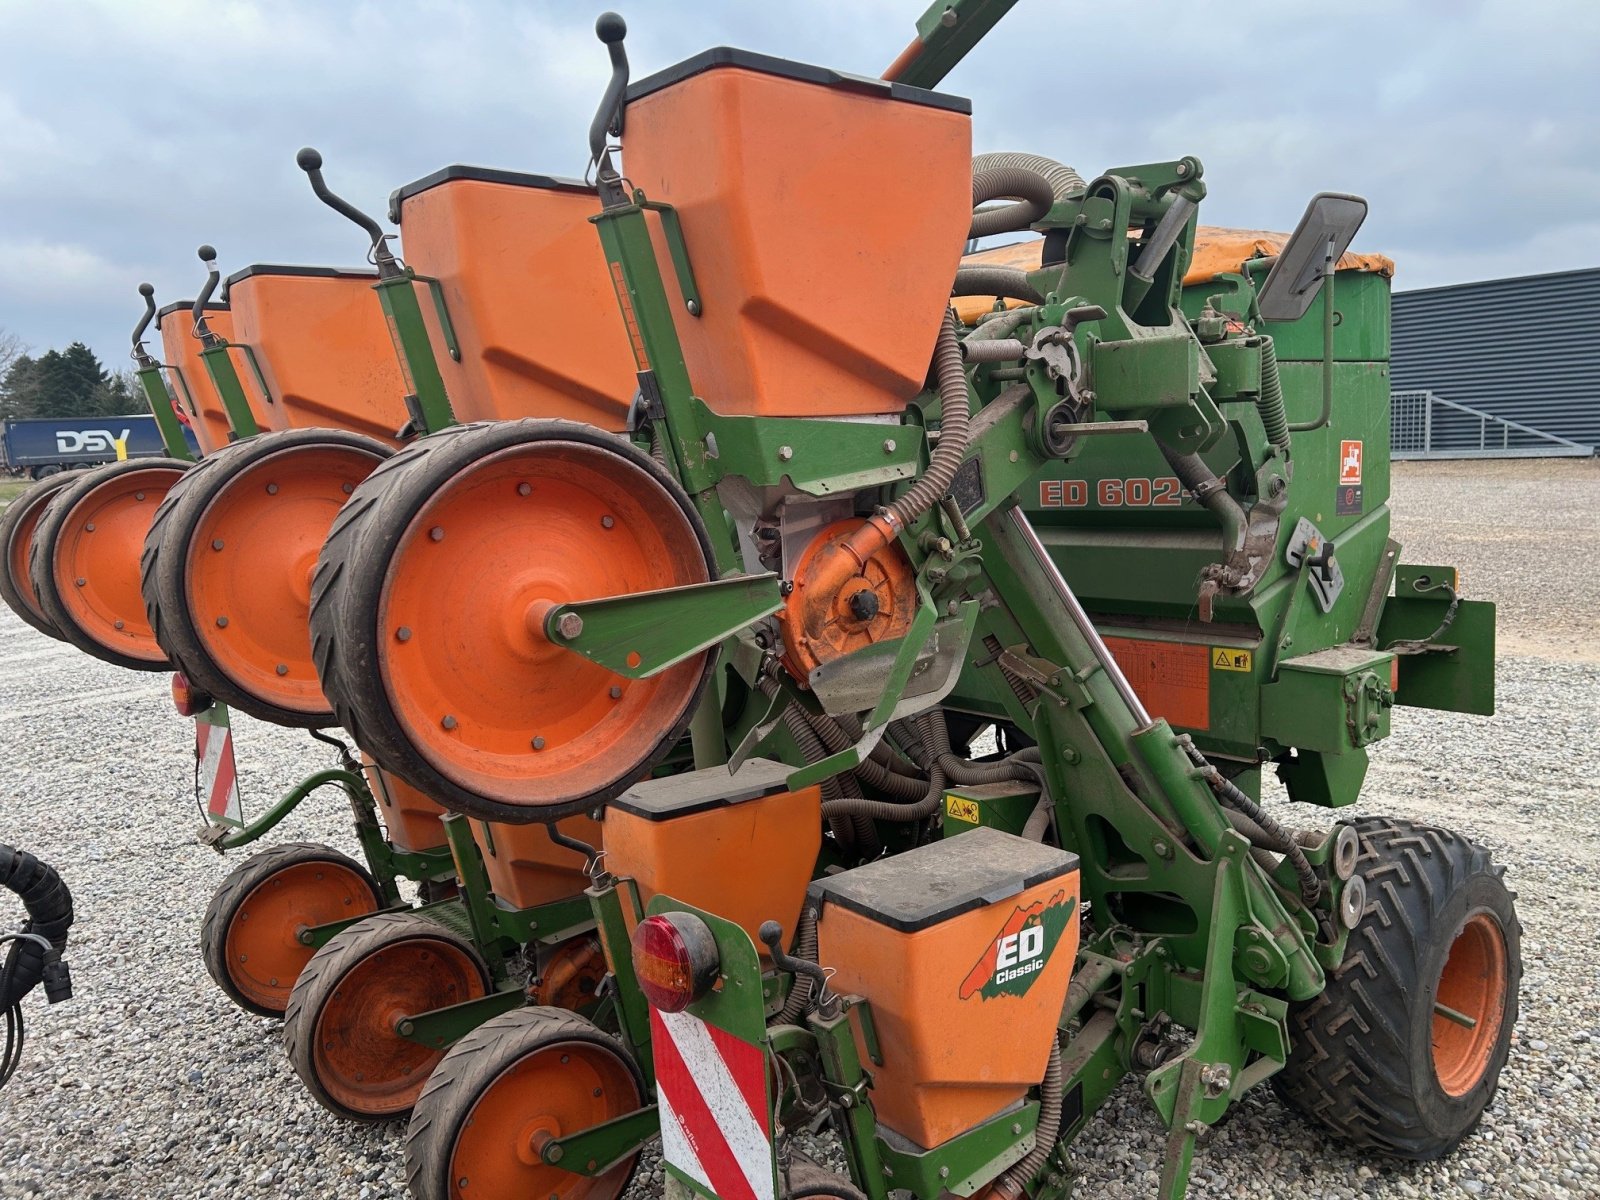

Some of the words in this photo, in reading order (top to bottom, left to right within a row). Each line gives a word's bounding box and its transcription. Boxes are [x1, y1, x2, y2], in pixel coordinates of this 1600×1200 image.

[56, 429, 130, 453] DSV
[1039, 480, 1088, 507] ED
[1097, 476, 1226, 507] 602-
[996, 925, 1044, 971] ED
[996, 959, 1044, 985] Classic
